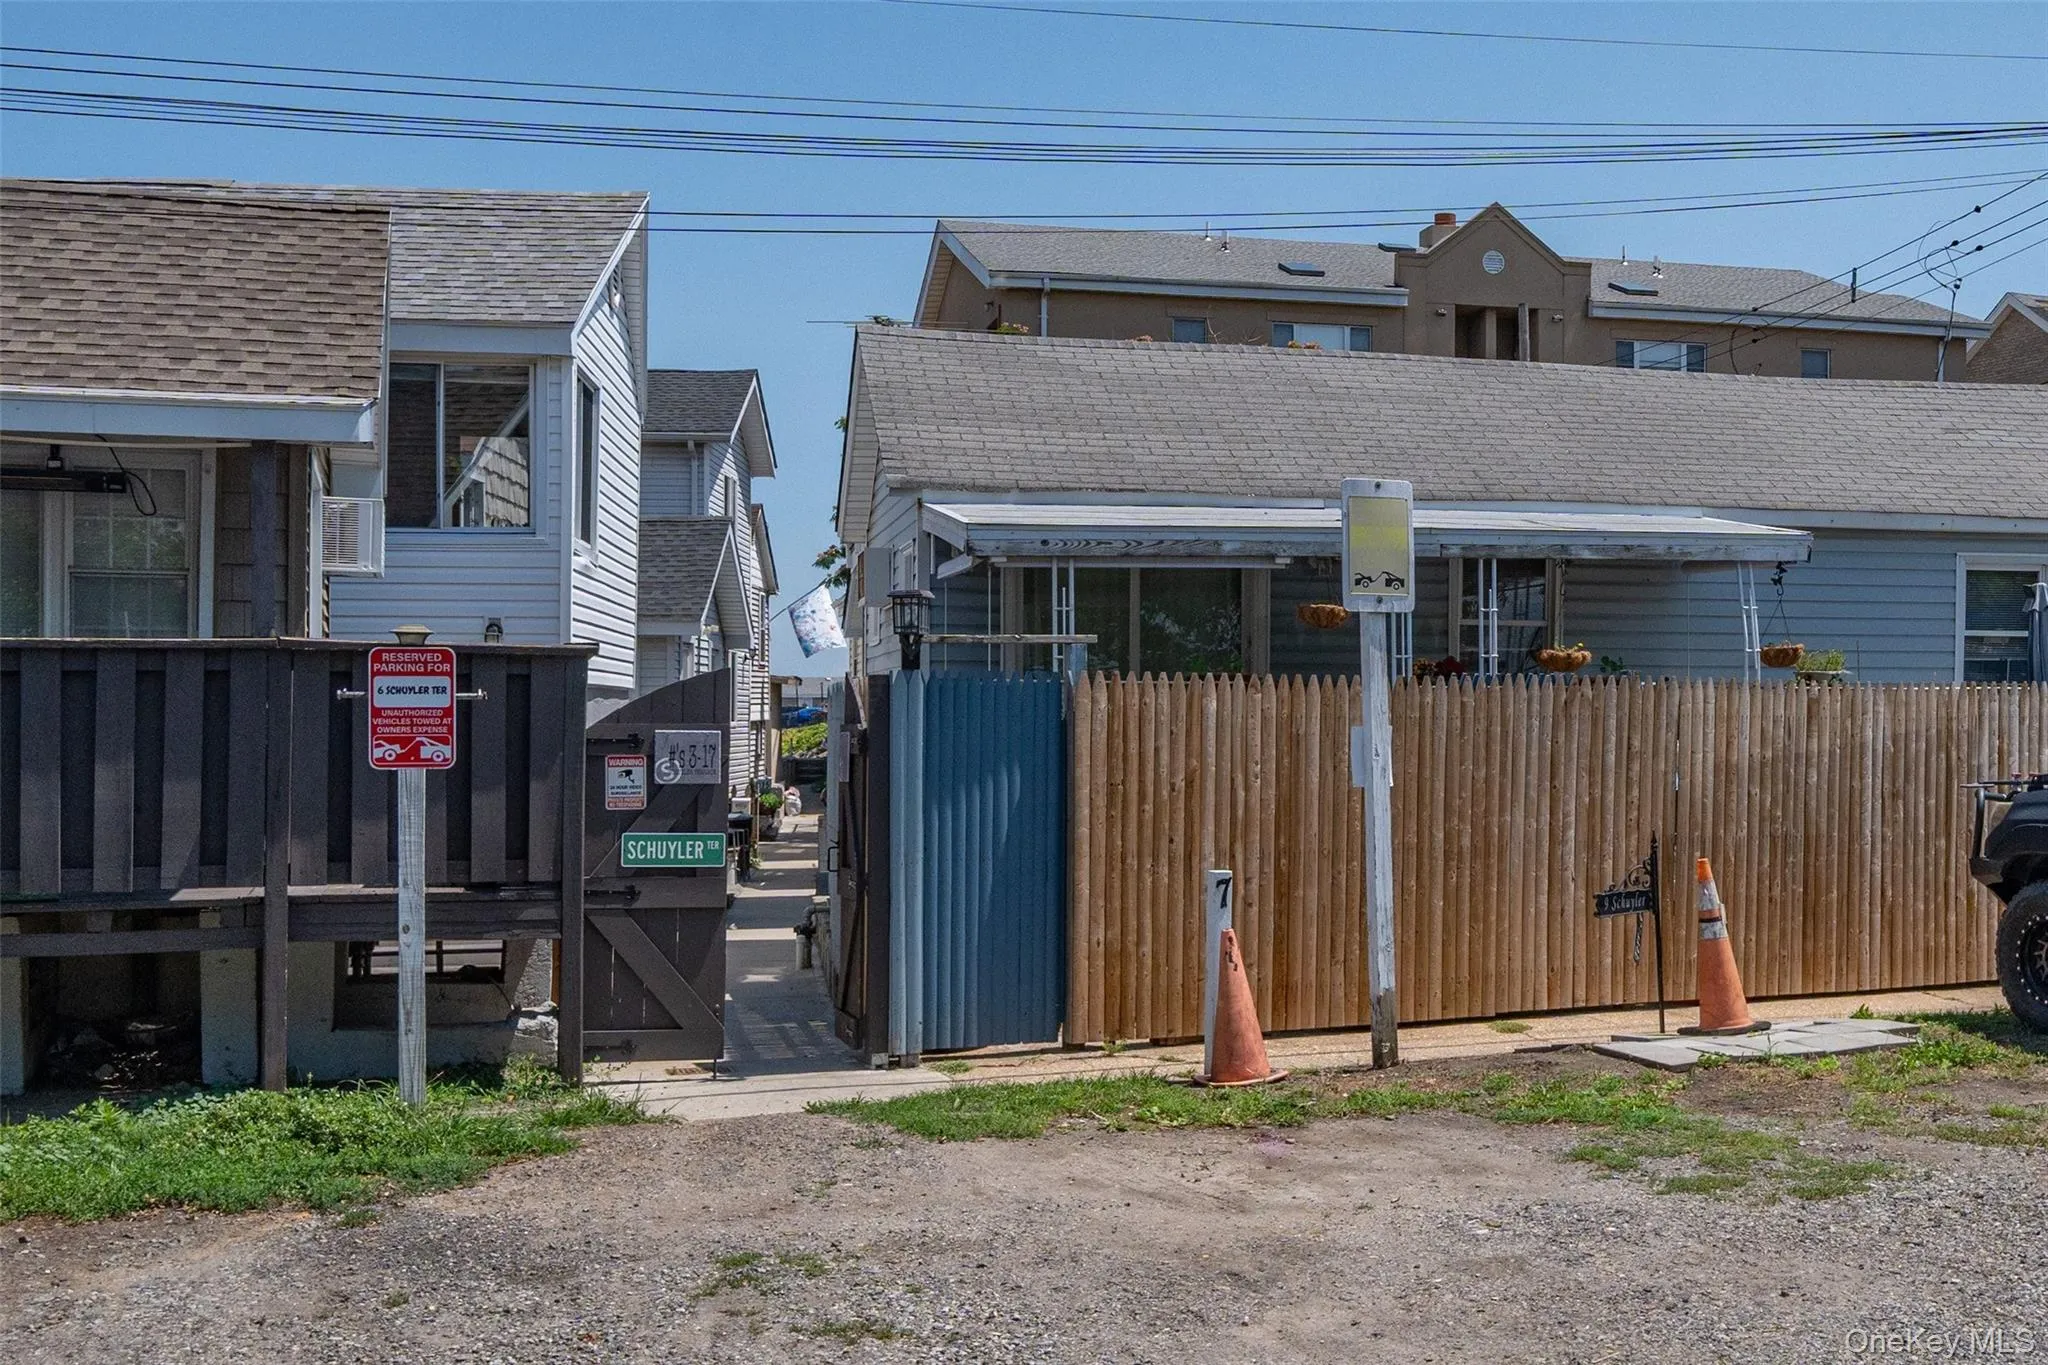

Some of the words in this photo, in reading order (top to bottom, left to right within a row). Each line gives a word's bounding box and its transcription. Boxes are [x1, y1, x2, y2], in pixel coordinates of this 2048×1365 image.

[382, 652, 442, 662] RESERVED
[373, 663, 425, 672] PARKING
[427, 663, 451, 672] FOR
[377, 686, 384, 695] 6
[386, 686, 430, 695] SCHUYLER
[431, 686, 448, 695] TER
[381, 709, 443, 717] UNAUTHORIZED
[372, 717, 412, 725] VEHICLES
[412, 717, 441, 725] TOWED
[442, 717, 452, 725] AT
[377, 726, 412, 734] OWNERS
[413, 726, 448, 734] EXPENSE
[688, 744, 717, 769] 3-17
[609, 758, 644, 767] WARNING
[627, 840, 704, 860] SCHUYLER
[706, 841, 719, 850] TER
[1216, 877, 1232, 909] 7
